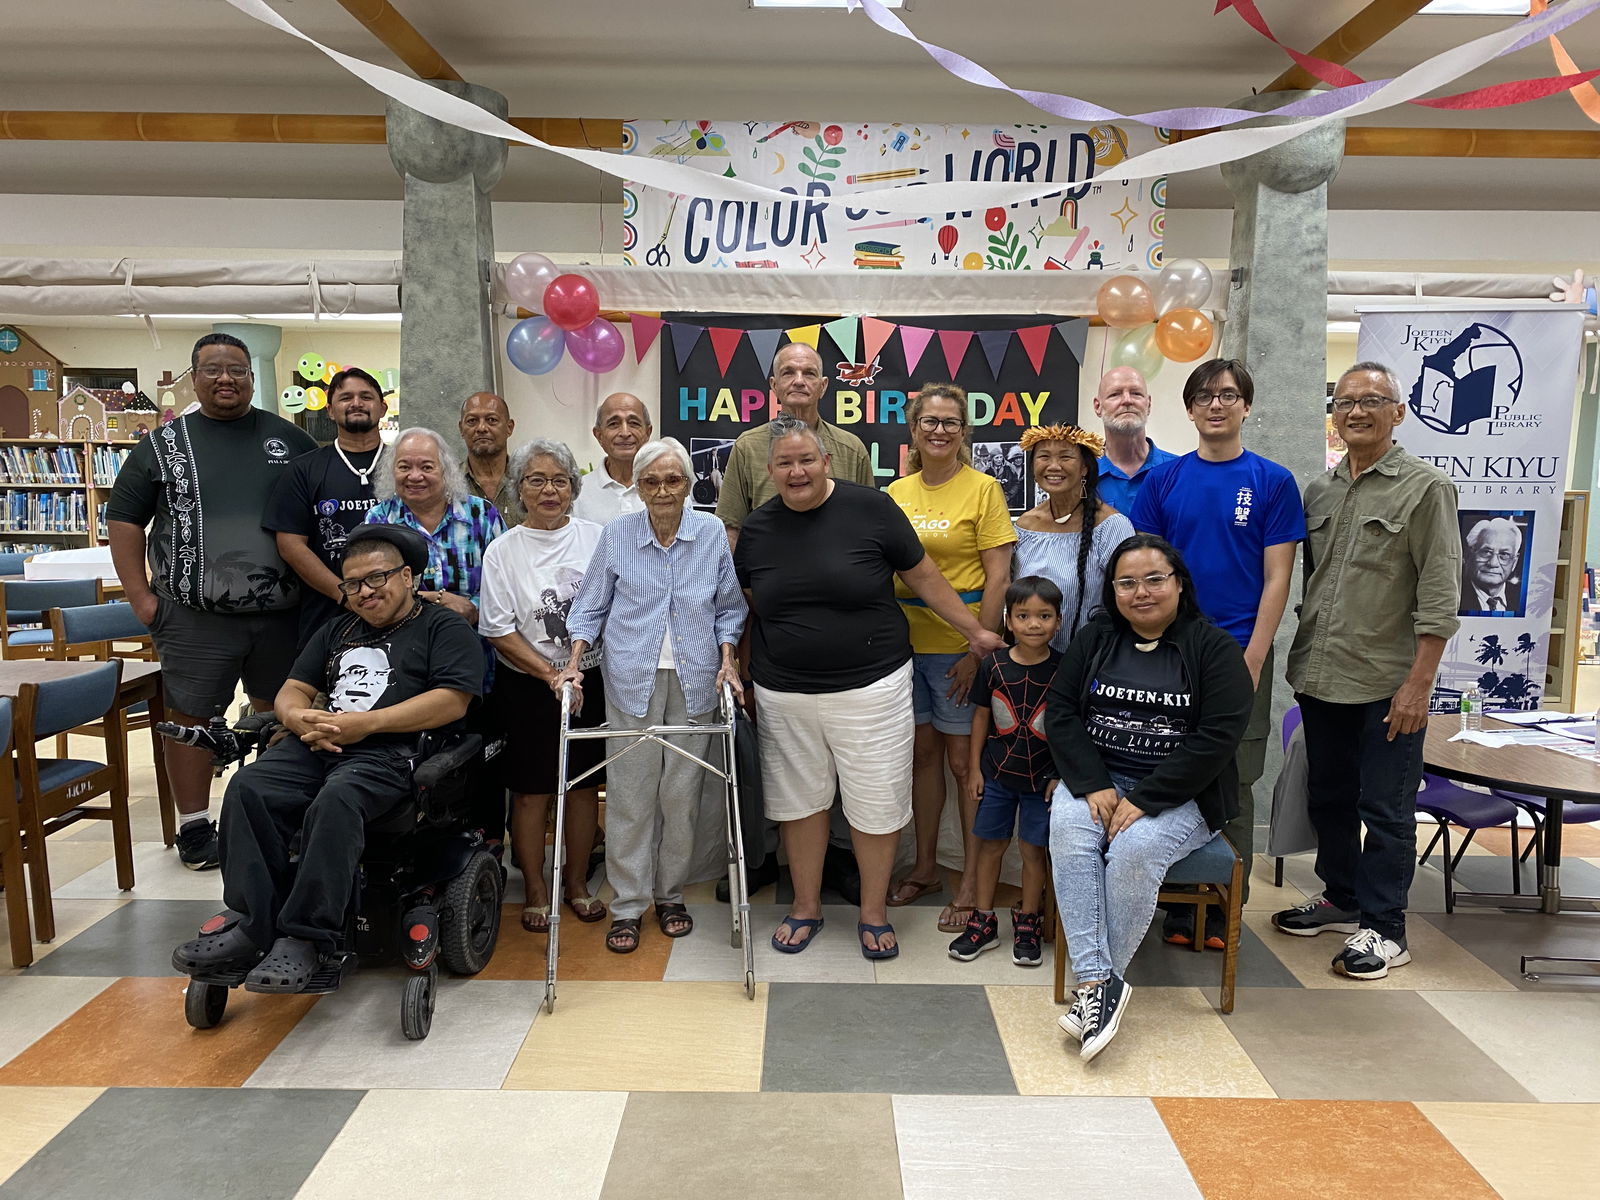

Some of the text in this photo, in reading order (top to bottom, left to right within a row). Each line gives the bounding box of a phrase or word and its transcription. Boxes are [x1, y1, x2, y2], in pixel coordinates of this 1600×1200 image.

[684, 181, 832, 265] COLOR
[1401, 324, 1453, 345] JOETEN
[1412, 337, 1453, 352] KIYU
[836, 389, 1051, 427] BIRDAY
[1493, 405, 1543, 421] PUBLIC
[1486, 421, 1543, 436] LIBRARY
[1482, 456, 1560, 478] KIYU
[1458, 485, 1557, 495] LIBRARY
[339, 498, 378, 511] JOETE
[1096, 683, 1192, 707] JOETEN-KIY
[1127, 734, 1180, 749] Librar
